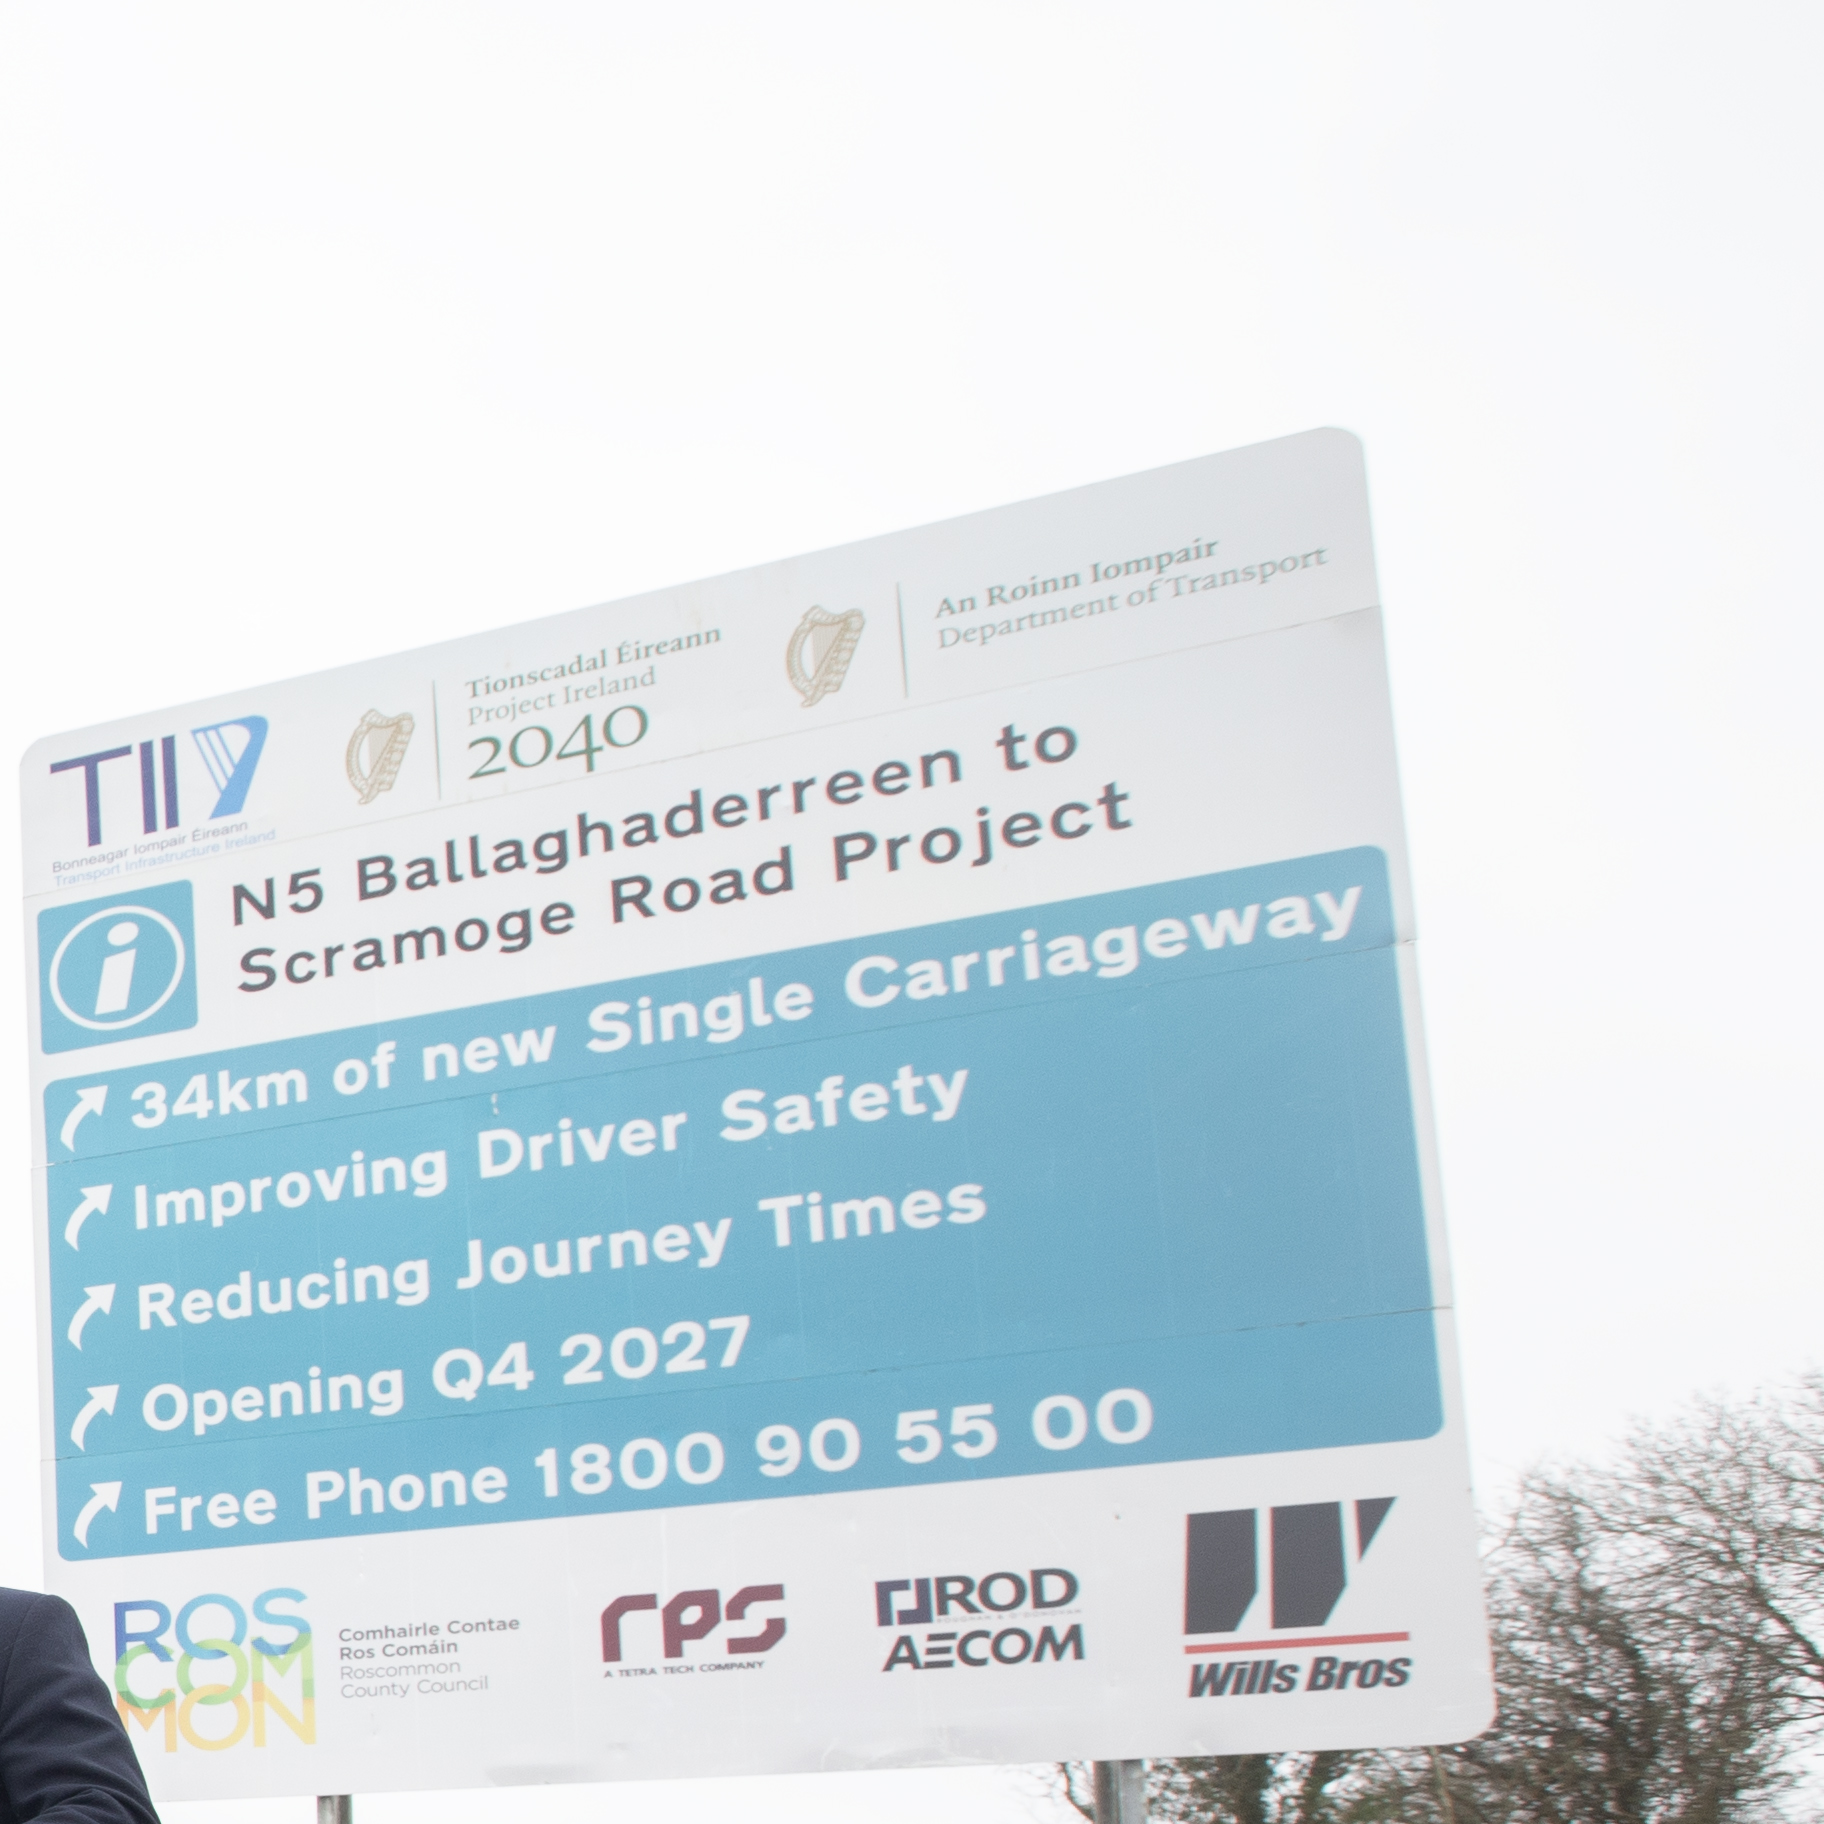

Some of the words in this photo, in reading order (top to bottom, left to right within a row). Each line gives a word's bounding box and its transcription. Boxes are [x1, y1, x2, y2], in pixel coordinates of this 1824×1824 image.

[934, 597, 977, 619] An
[986, 571, 1083, 607] Roinn
[1090, 537, 1220, 584] Iompair
[938, 595, 1120, 650] Department
[1127, 578, 1164, 607] of
[1165, 547, 1330, 600] Transport
[465, 649, 608, 699] Tionscadal
[616, 628, 723, 664] Éireann
[468, 692, 556, 727] Project
[563, 666, 657, 704] Ireland
[467, 704, 650, 780] 2040
[52, 847, 129, 874] Bonneagar
[54, 862, 122, 888] Transport
[125, 843, 220, 871] Infrastructure
[224, 829, 277, 849] Ireland
[231, 867, 325, 928] N5
[356, 746, 963, 903] Ballaghaderreen
[994, 722, 1080, 775] to
[236, 900, 577, 994] Scramoge
[610, 845, 796, 925] Road
[832, 780, 1135, 884] Project
[129, 1066, 309, 1131] 34km
[332, 1040, 398, 1097] of
[421, 1023, 558, 1083] new
[584, 976, 815, 1056] Single
[843, 884, 1364, 1009] Carriageway
[133, 1148, 450, 1231] Improving
[477, 1110, 689, 1181] Driver
[718, 1063, 970, 1143] Safety
[137, 1255, 432, 1332] Reducing
[456, 1216, 734, 1291] Journey
[757, 1182, 989, 1249] Times
[141, 1364, 406, 1438] Opening
[431, 1340, 536, 1403] Q4
[559, 1313, 752, 1388] 2027
[143, 1484, 278, 1537] Free
[305, 1464, 509, 1522] Phone
[534, 1431, 726, 1500] 1800
[754, 1416, 862, 1479] 90
[894, 1403, 1000, 1466] 55
[1029, 1386, 1155, 1453] 00
[112, 1586, 314, 1665] ROS
[933, 1567, 1080, 1617] ROD
[338, 1622, 441, 1643] Comhairle
[447, 1618, 521, 1635] Contae
[339, 1646, 376, 1661] Ros
[382, 1639, 459, 1658] Comáin
[881, 1623, 1085, 1672] AECOM
[340, 1661, 462, 1681] Roscommon
[340, 1682, 411, 1699] County
[417, 1675, 490, 1695] Council
[604, 1669, 613, 1678] A
[618, 1667, 658, 1678] TETRA
[662, 1665, 695, 1675] TECH
[699, 1660, 765, 1673] COMPANY
[1188, 1659, 1301, 1698] Wills
[1305, 1655, 1414, 1692] Bros
